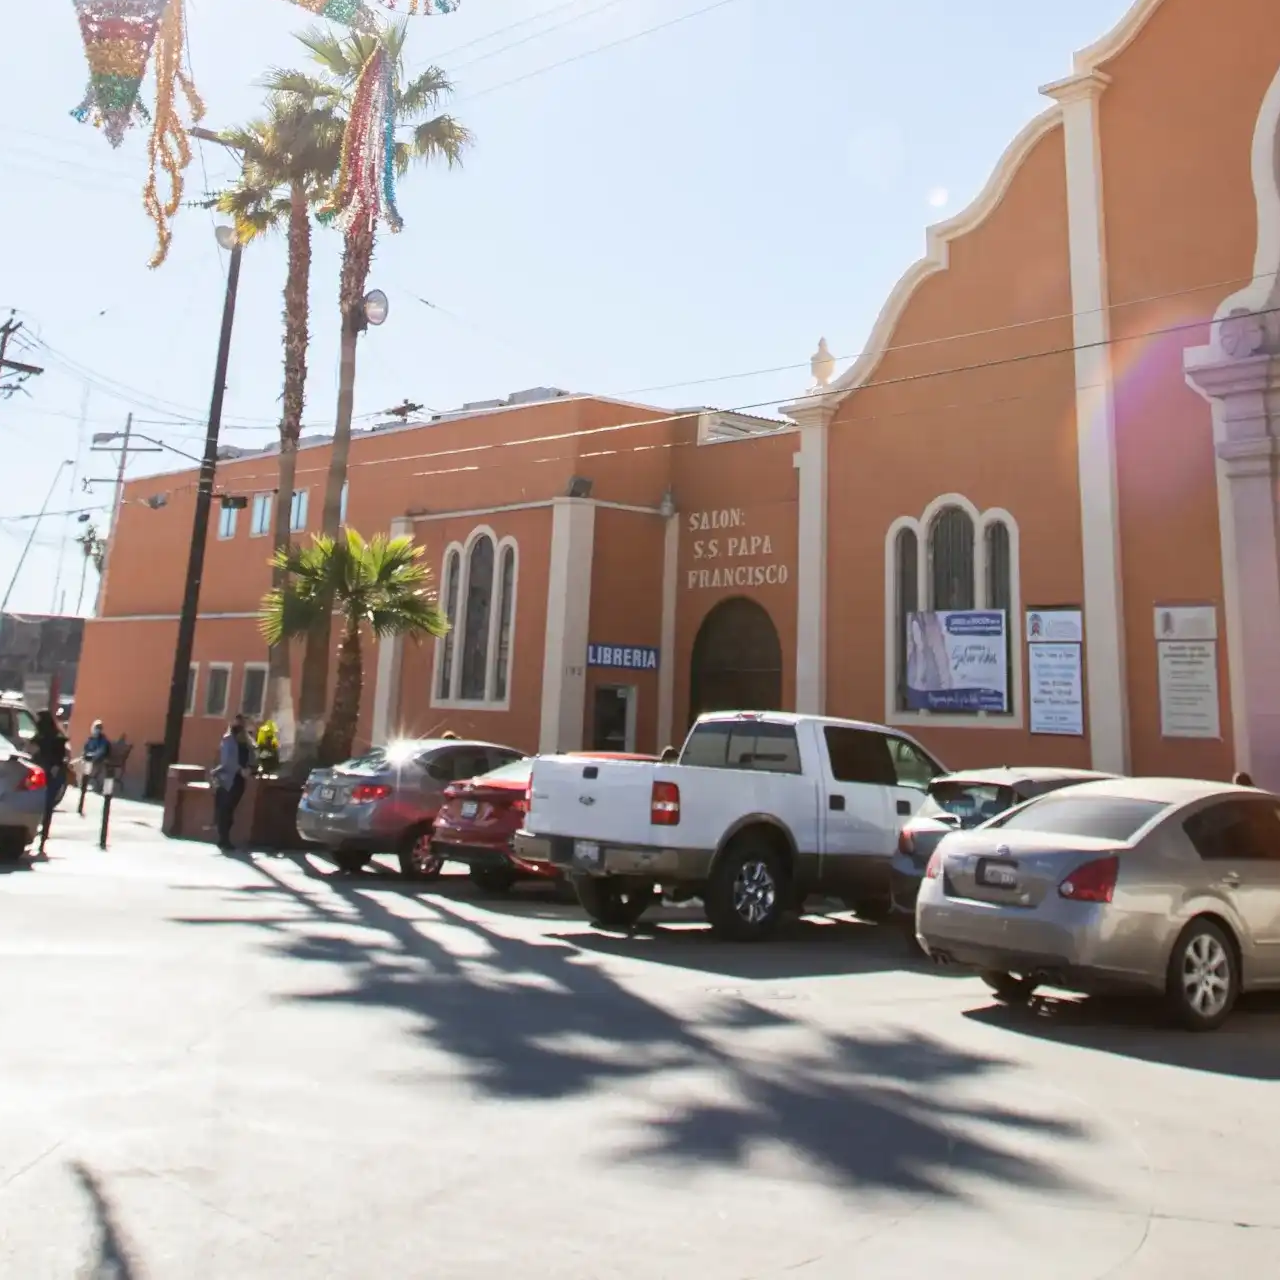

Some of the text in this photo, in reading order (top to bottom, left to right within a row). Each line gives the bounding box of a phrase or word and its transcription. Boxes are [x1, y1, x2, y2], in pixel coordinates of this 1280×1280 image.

[688, 508, 745, 532] SALON:
[694, 535, 773, 560] S.S. PAPA
[687, 564, 788, 589] FRANCISCO
[588, 645, 657, 669] LIBRERIA
